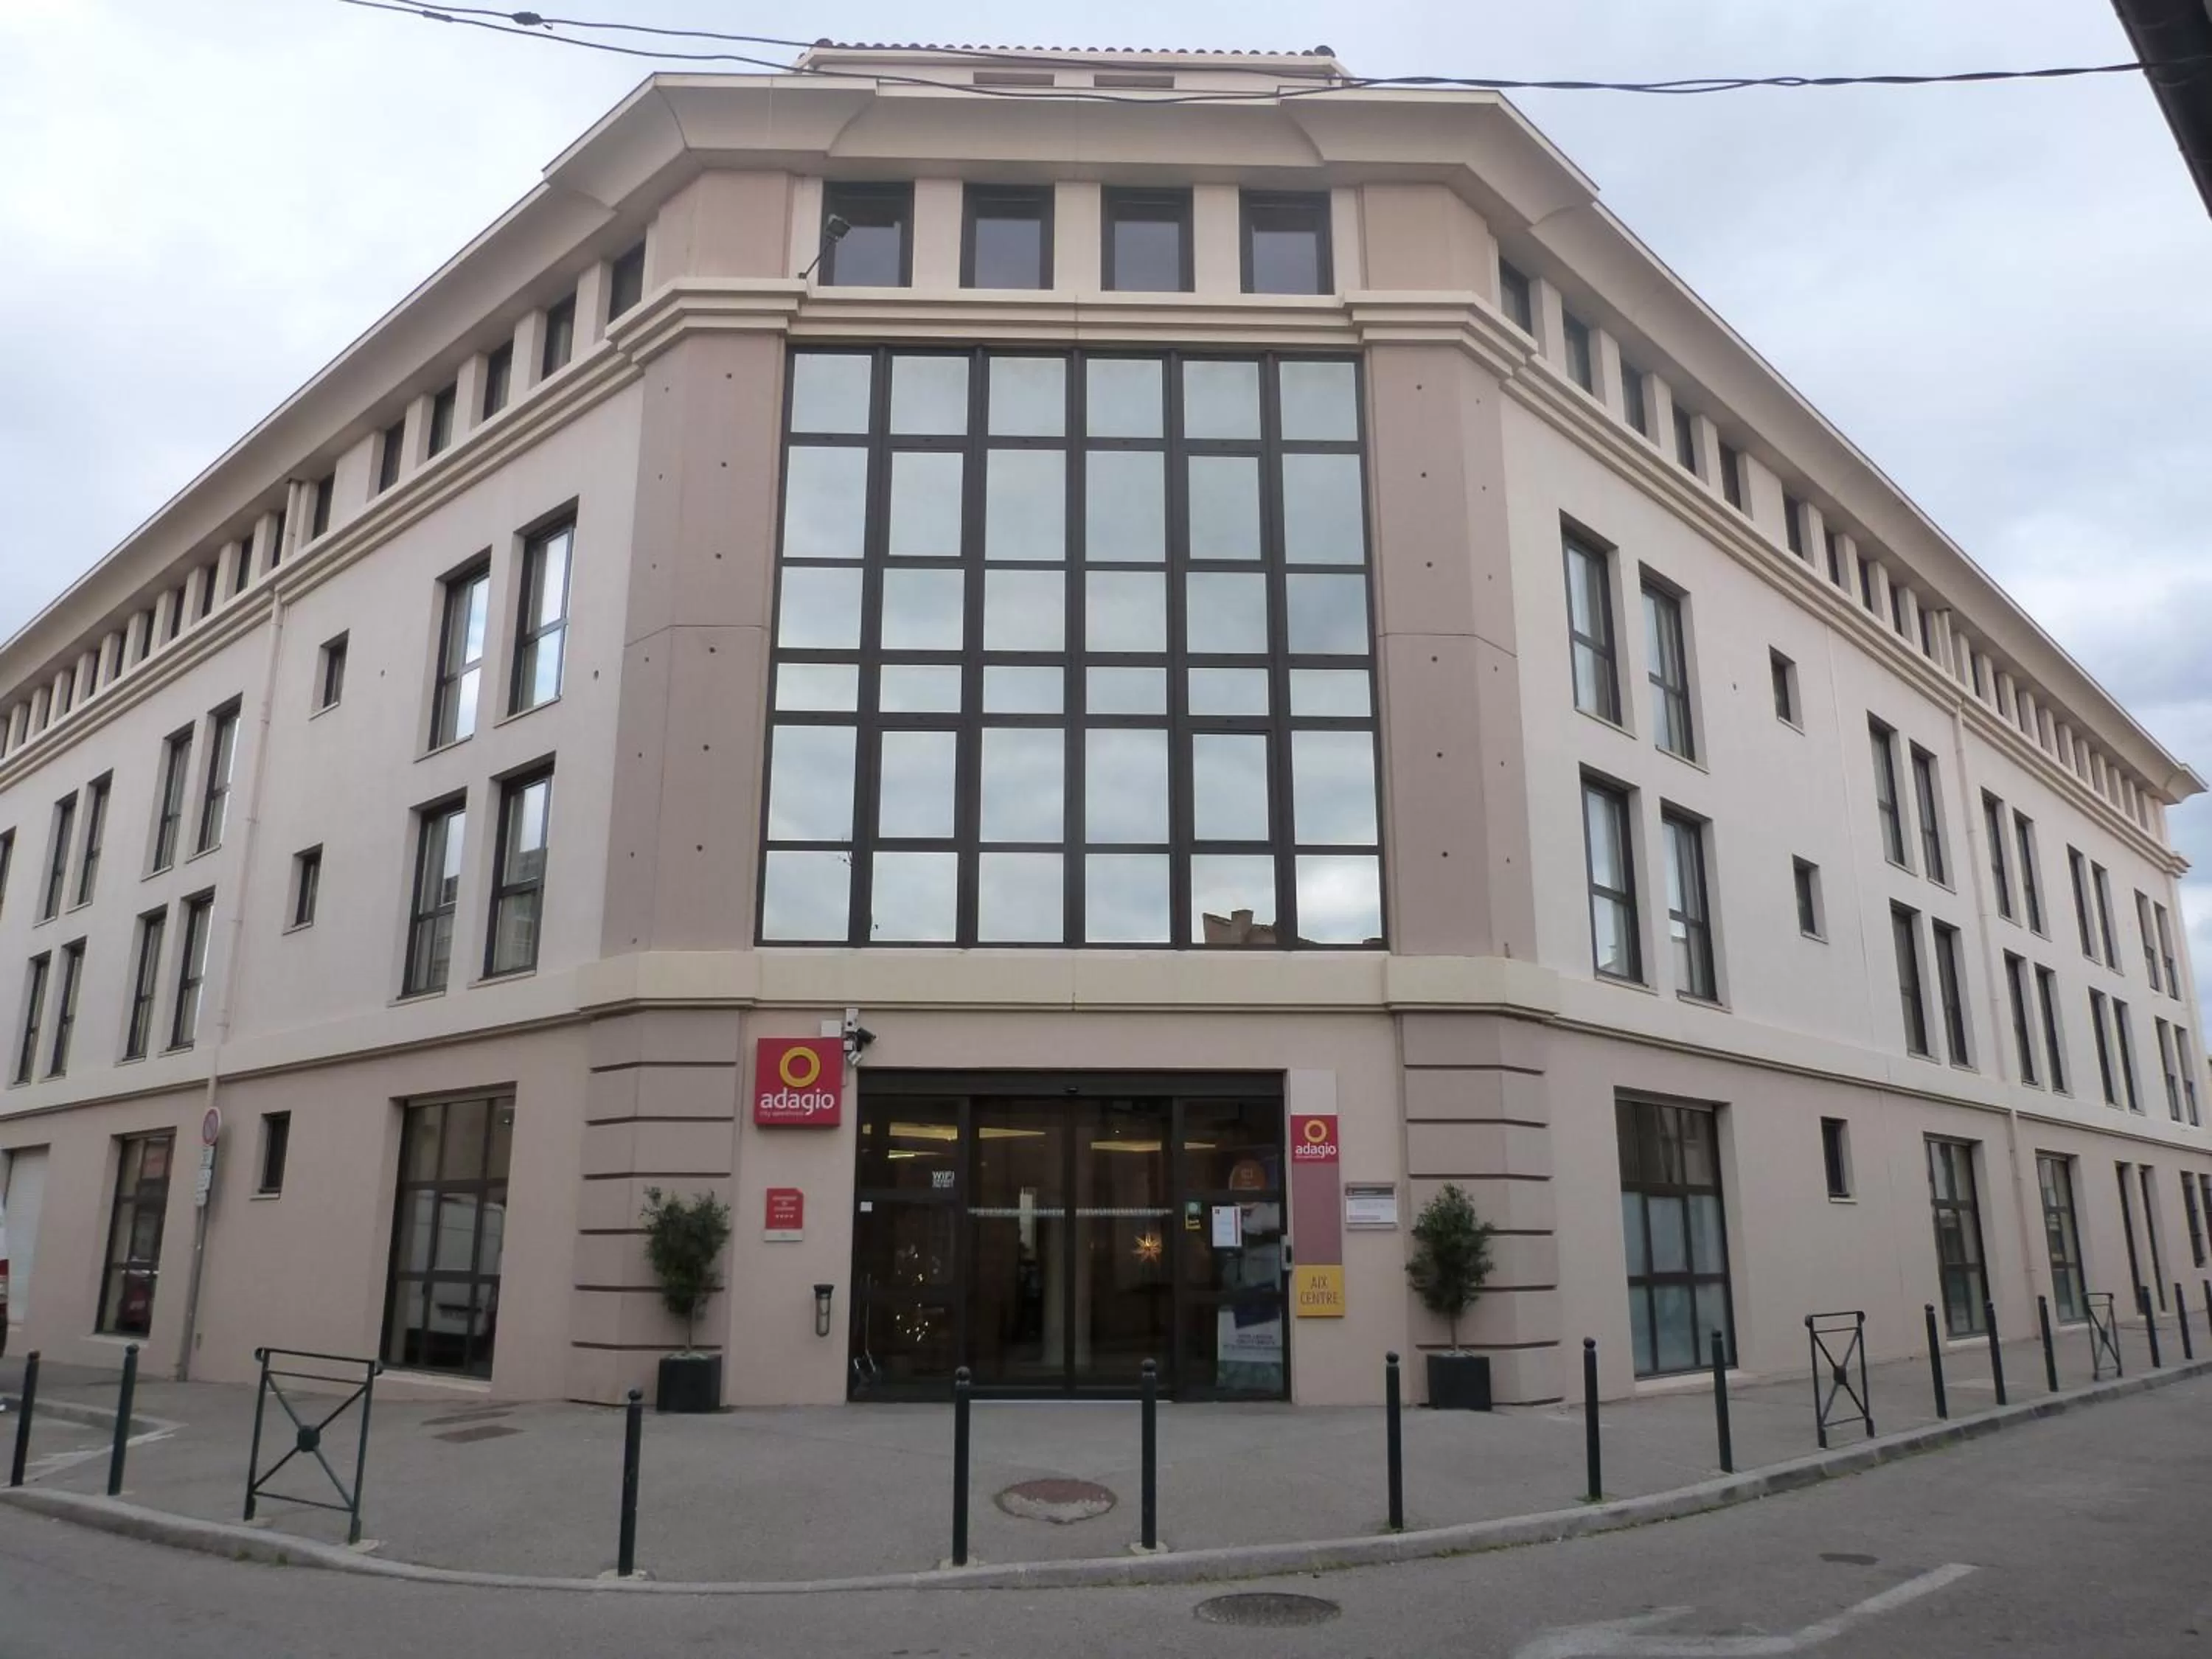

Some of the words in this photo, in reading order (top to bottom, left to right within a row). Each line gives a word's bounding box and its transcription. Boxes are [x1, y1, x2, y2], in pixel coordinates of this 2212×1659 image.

[760, 1088, 835, 1115] adagio
[1295, 1142, 1337, 1159] adagio
[1310, 1274, 1329, 1290] AIX
[1300, 1291, 1340, 1305] CENTRE
